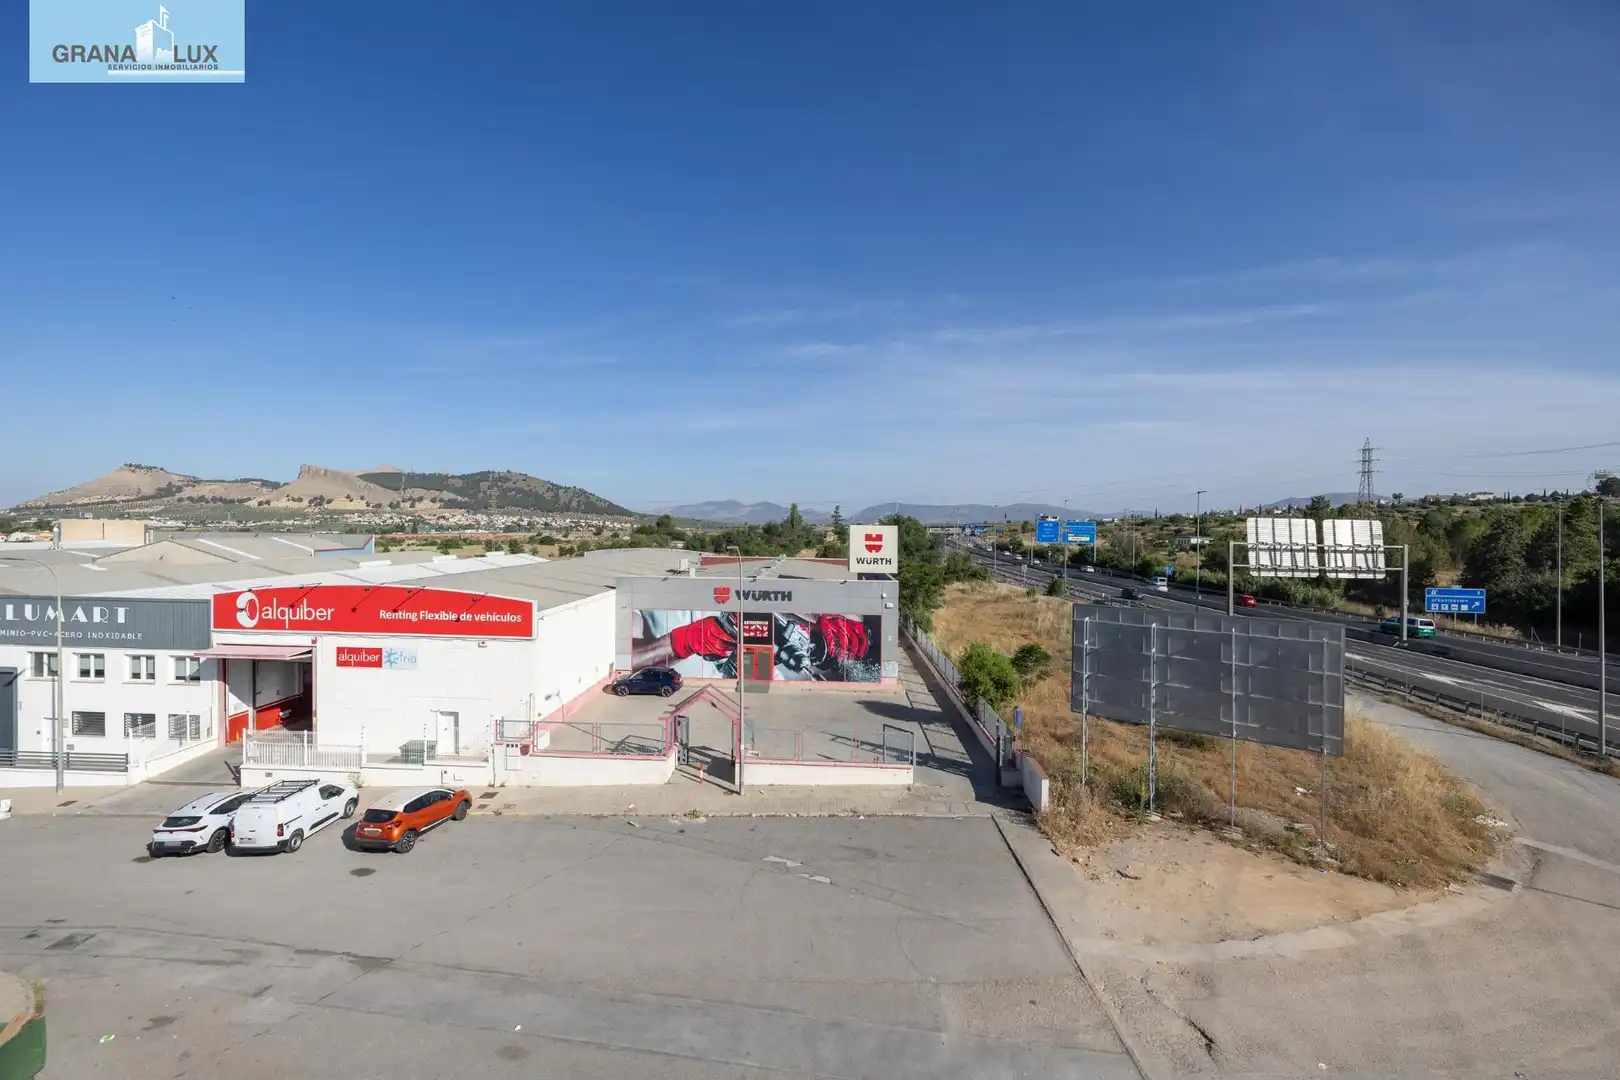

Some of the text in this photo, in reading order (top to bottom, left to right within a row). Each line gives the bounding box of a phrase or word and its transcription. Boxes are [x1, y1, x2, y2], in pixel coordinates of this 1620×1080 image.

[856, 557, 892, 566] WÜRTH
[735, 590, 792, 602] WÜRTH
[0, 603, 130, 624] LUMART
[261, 597, 335, 629] alquiber
[379, 609, 522, 623] Renting Flexible de vehículos
[87, 631, 143, 640] INOXIDABLE
[338, 648, 381, 667] alquiber
